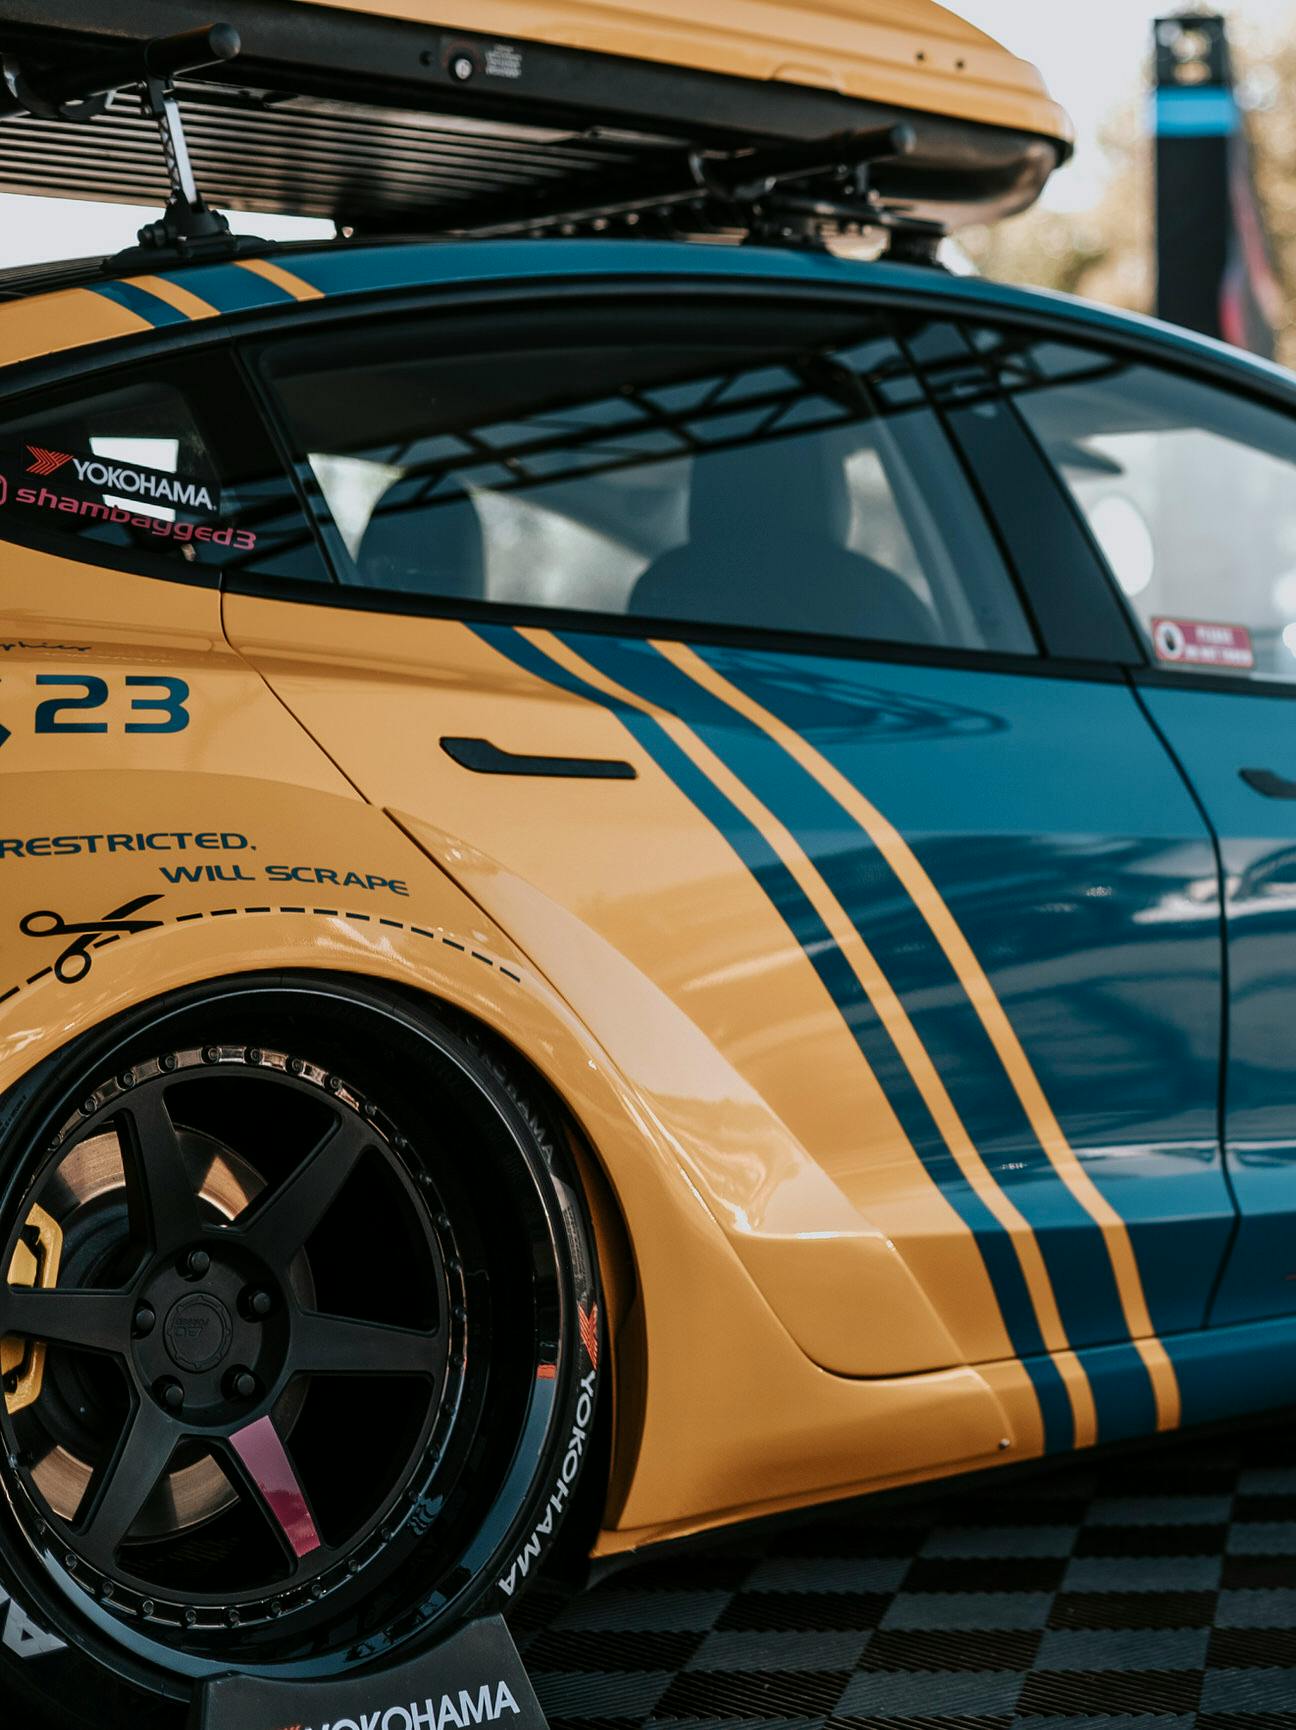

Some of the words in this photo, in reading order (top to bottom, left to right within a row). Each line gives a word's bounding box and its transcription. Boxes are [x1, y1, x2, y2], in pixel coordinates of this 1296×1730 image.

[72, 458, 213, 510] YOKOHAMA
[34, 674, 190, 734] 23
[159, 864, 256, 884] WILL
[265, 865, 410, 897] SCRAPE
[498, 1369, 597, 1597] YOKOHAMA
[304, 1679, 521, 1730] KOHAMA
